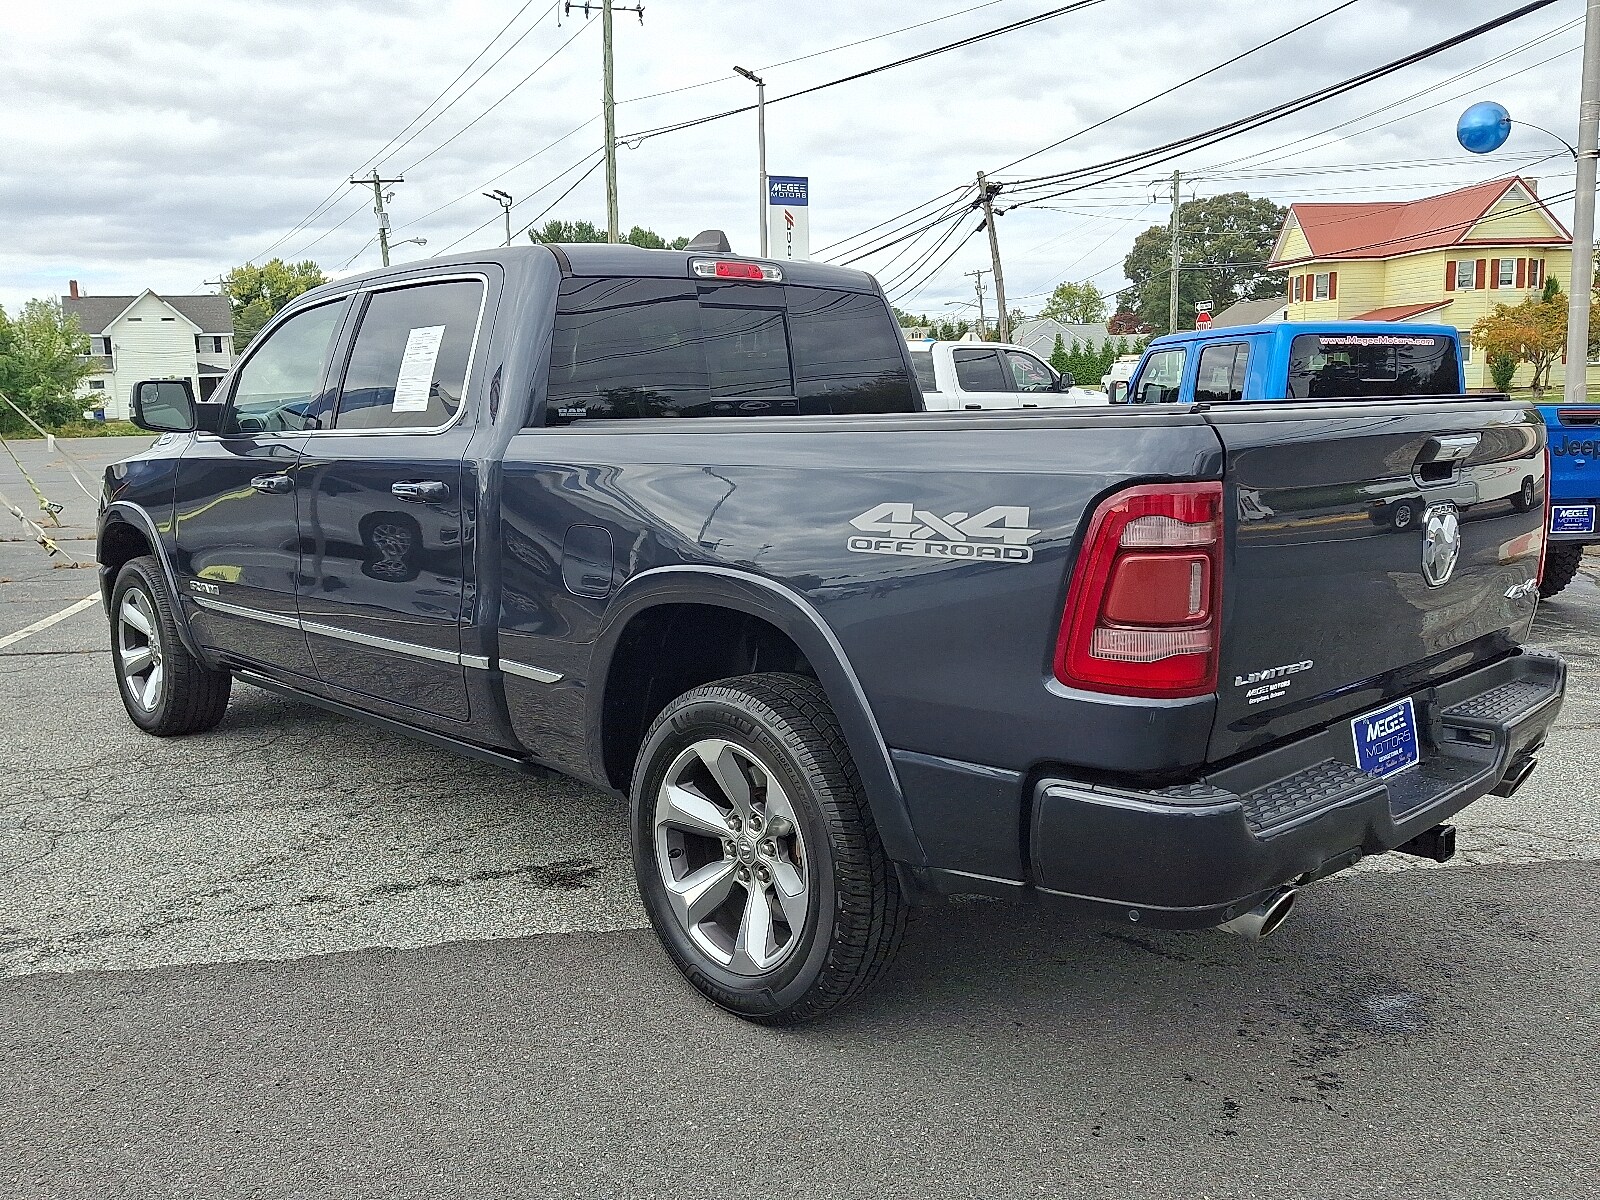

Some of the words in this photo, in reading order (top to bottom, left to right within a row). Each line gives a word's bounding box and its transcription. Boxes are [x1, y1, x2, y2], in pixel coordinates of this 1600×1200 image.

[771, 183, 806, 192] MEGEE
[1196, 321, 1212, 331] STOP
[1319, 336, 1435, 346] www.MegeeMotors.com
[1560, 510, 1588, 518] MEGEE
[851, 538, 917, 552] OFF
[924, 543, 1029, 560] ROAD
[1234, 660, 1314, 686] LIMITED
[1366, 710, 1407, 742] MEGEE
[1366, 729, 1410, 758] MOTORS
[762, 736, 792, 774] DEFENDER
